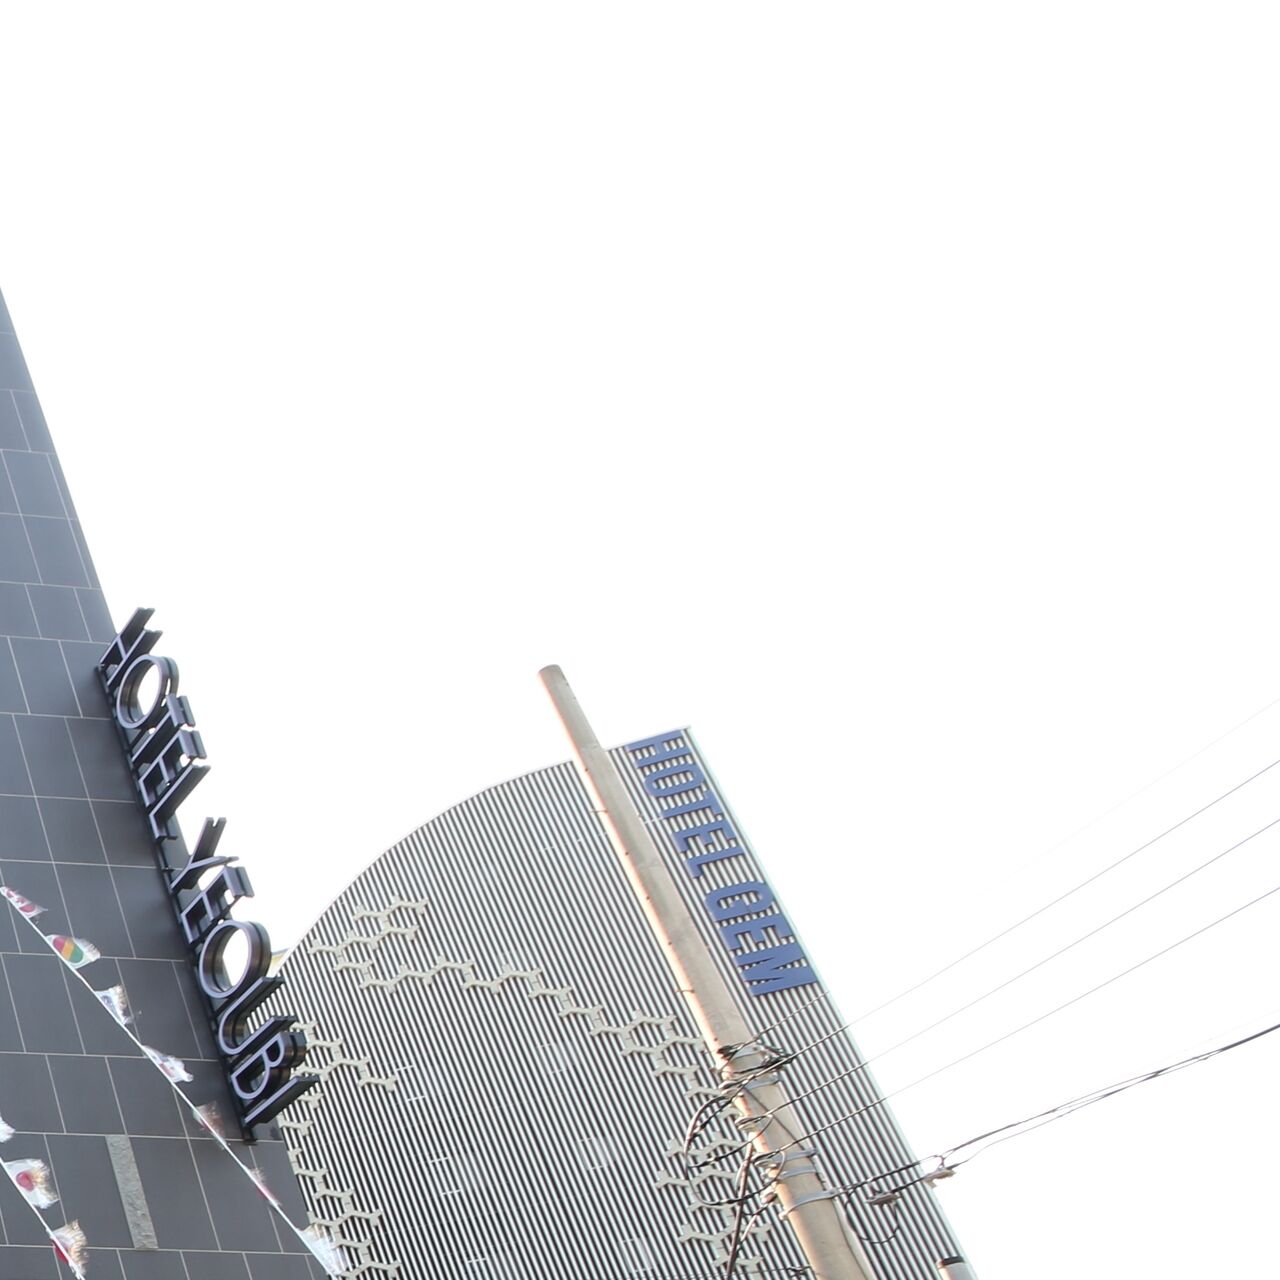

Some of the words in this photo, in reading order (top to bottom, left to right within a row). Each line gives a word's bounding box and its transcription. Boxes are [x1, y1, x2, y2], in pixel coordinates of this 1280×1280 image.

[97, 607, 210, 840] HOTEL
[169, 816, 321, 1129] YEOUBI
[626, 730, 745, 879] HOTEL
[705, 880, 820, 998] GEM
